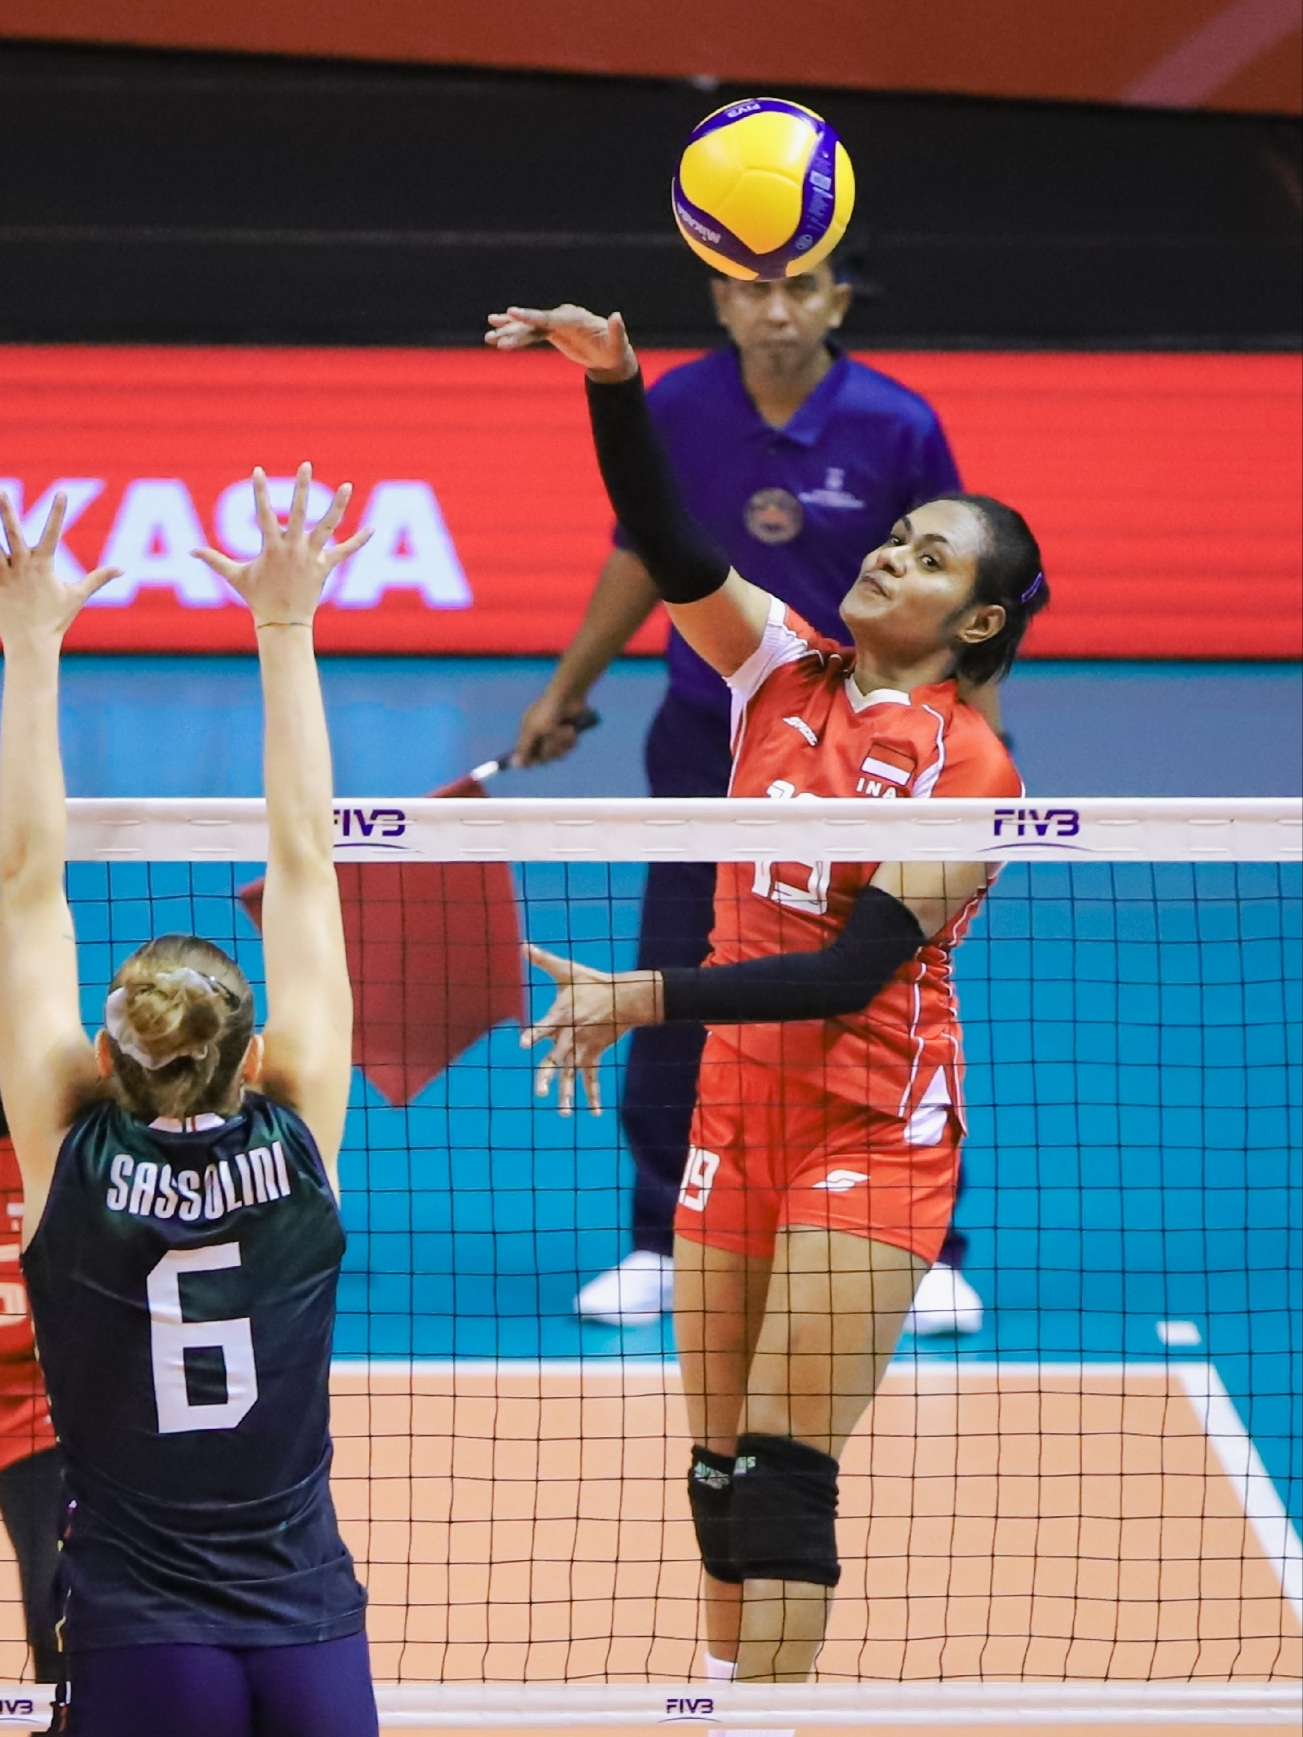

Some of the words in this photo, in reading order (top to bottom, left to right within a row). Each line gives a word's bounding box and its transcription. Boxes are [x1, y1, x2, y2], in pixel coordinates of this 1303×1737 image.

[993, 808, 1080, 837] FIVB
[106, 1141, 291, 1222] SASSOLINI
[678, 1144, 721, 1213] 19
[146, 1241, 259, 1434] 6
[666, 1698, 714, 1714] FIVB
